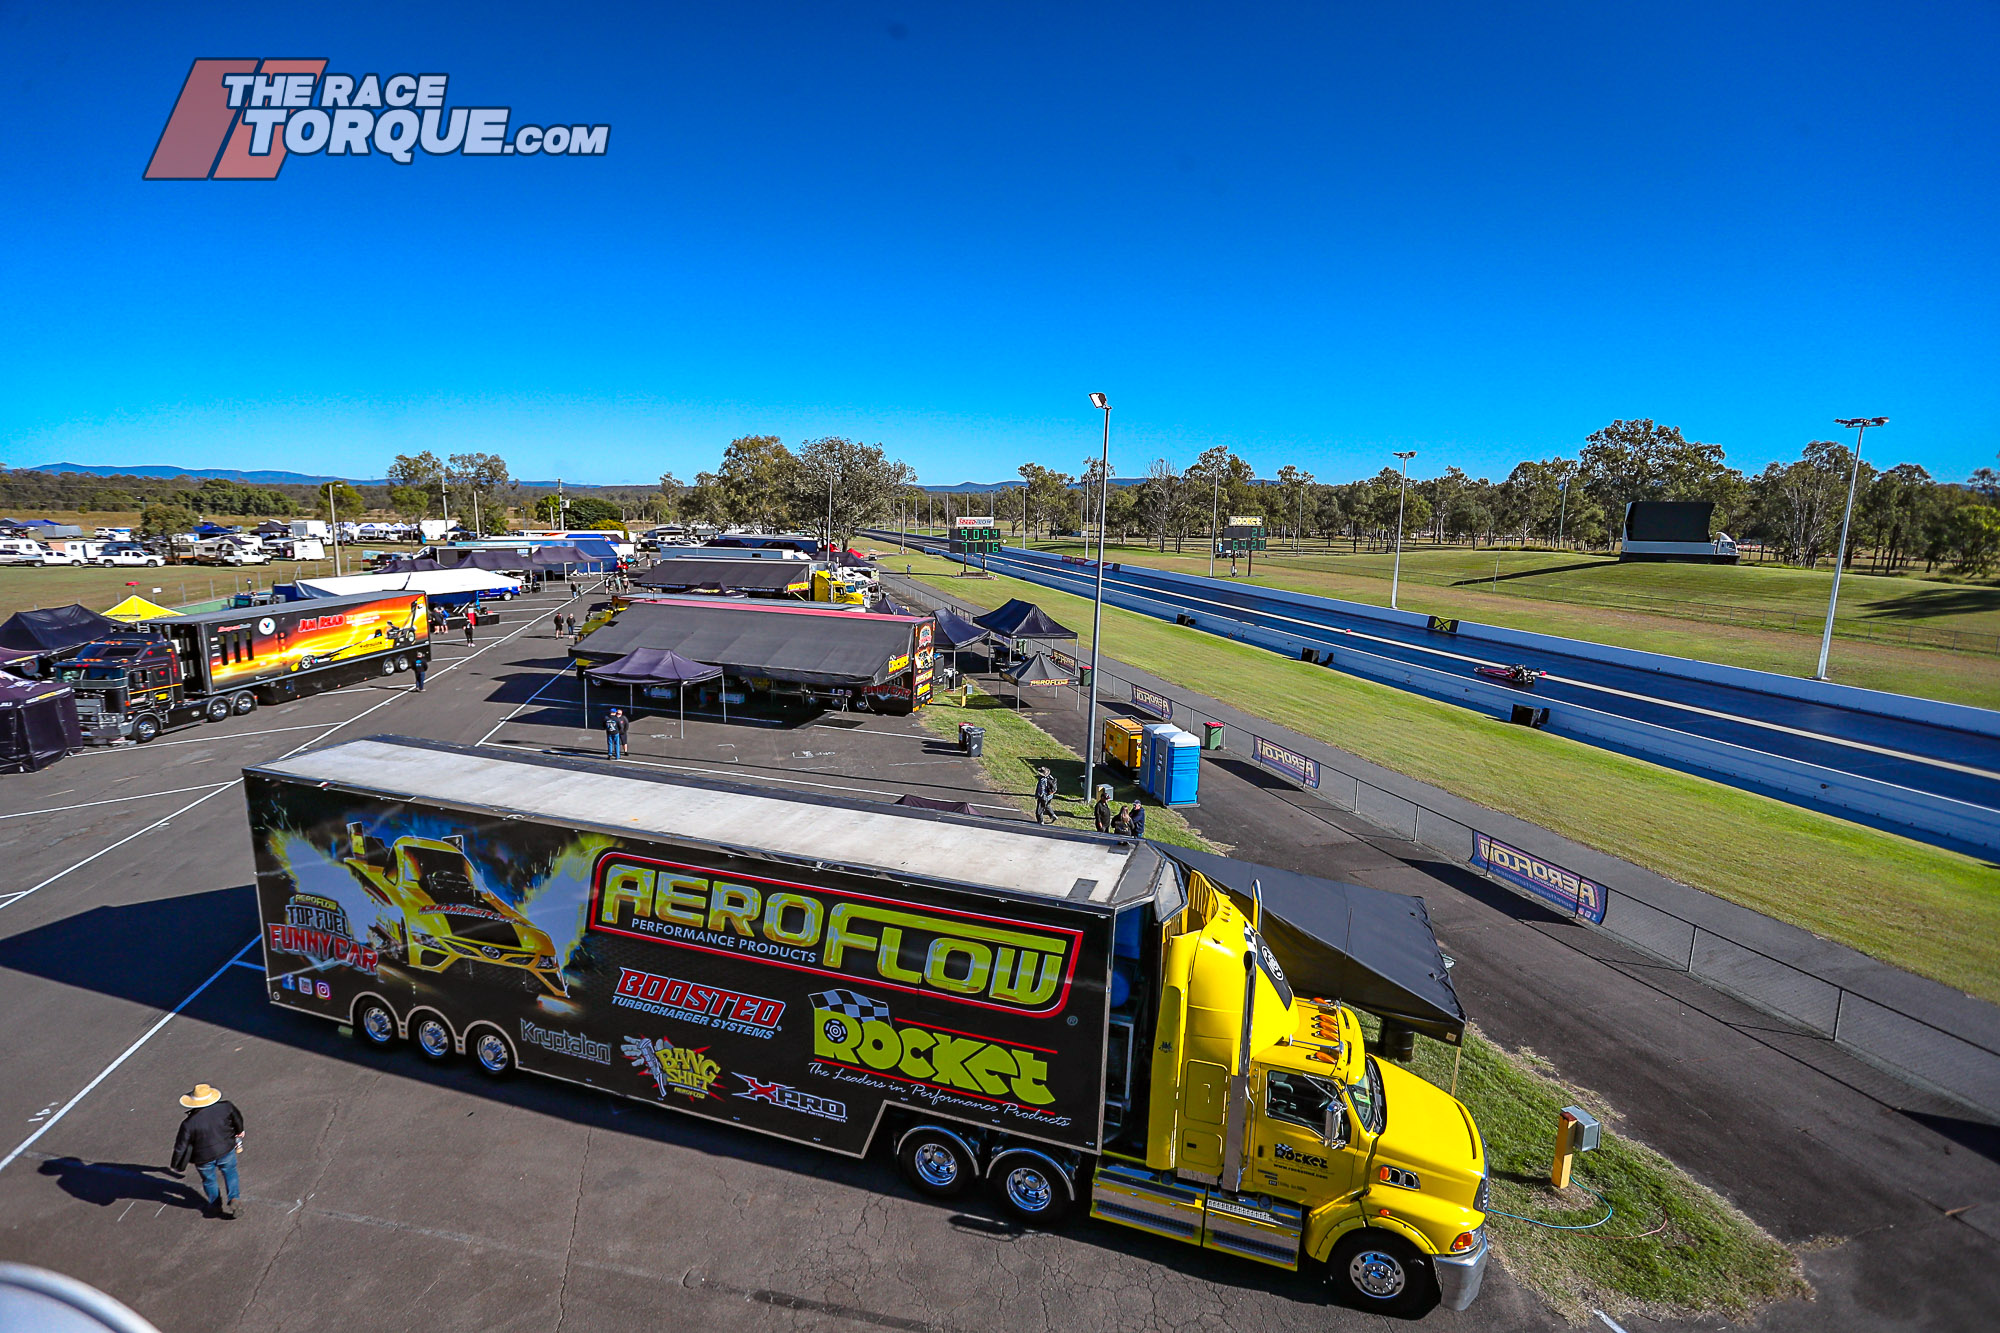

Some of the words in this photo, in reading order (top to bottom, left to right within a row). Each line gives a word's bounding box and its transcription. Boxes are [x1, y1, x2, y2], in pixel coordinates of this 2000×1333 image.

[298, 618, 317, 632] JIM
[318, 614, 345, 630] READ
[1030, 679, 1069, 687] AEROFLOW
[285, 905, 314, 926] TOP
[315, 910, 353, 940] FUEL
[295, 894, 337, 910] AEROFLOW
[267, 923, 333, 960] FUNNY
[334, 937, 379, 976] CAR
[601, 863, 1067, 1005] AEROFLOW
[631, 918, 735, 948] PERFORMANCE
[738, 939, 817, 963] PRODUCTS
[611, 996, 709, 1026] TURBOCHARGER
[711, 1018, 775, 1040] SYSTEMS
[614, 966, 787, 1029] BOOSTED
[520, 1018, 611, 1063] Kryptalon
[655, 1048, 720, 1081] BANG
[666, 1069, 714, 1091] SHIFT
[808, 1062, 830, 1077] The
[834, 1067, 886, 1090] Leaders
[888, 1081, 907, 1093] in
[911, 1083, 999, 1113] Performance
[1002, 1102, 1072, 1127] Products
